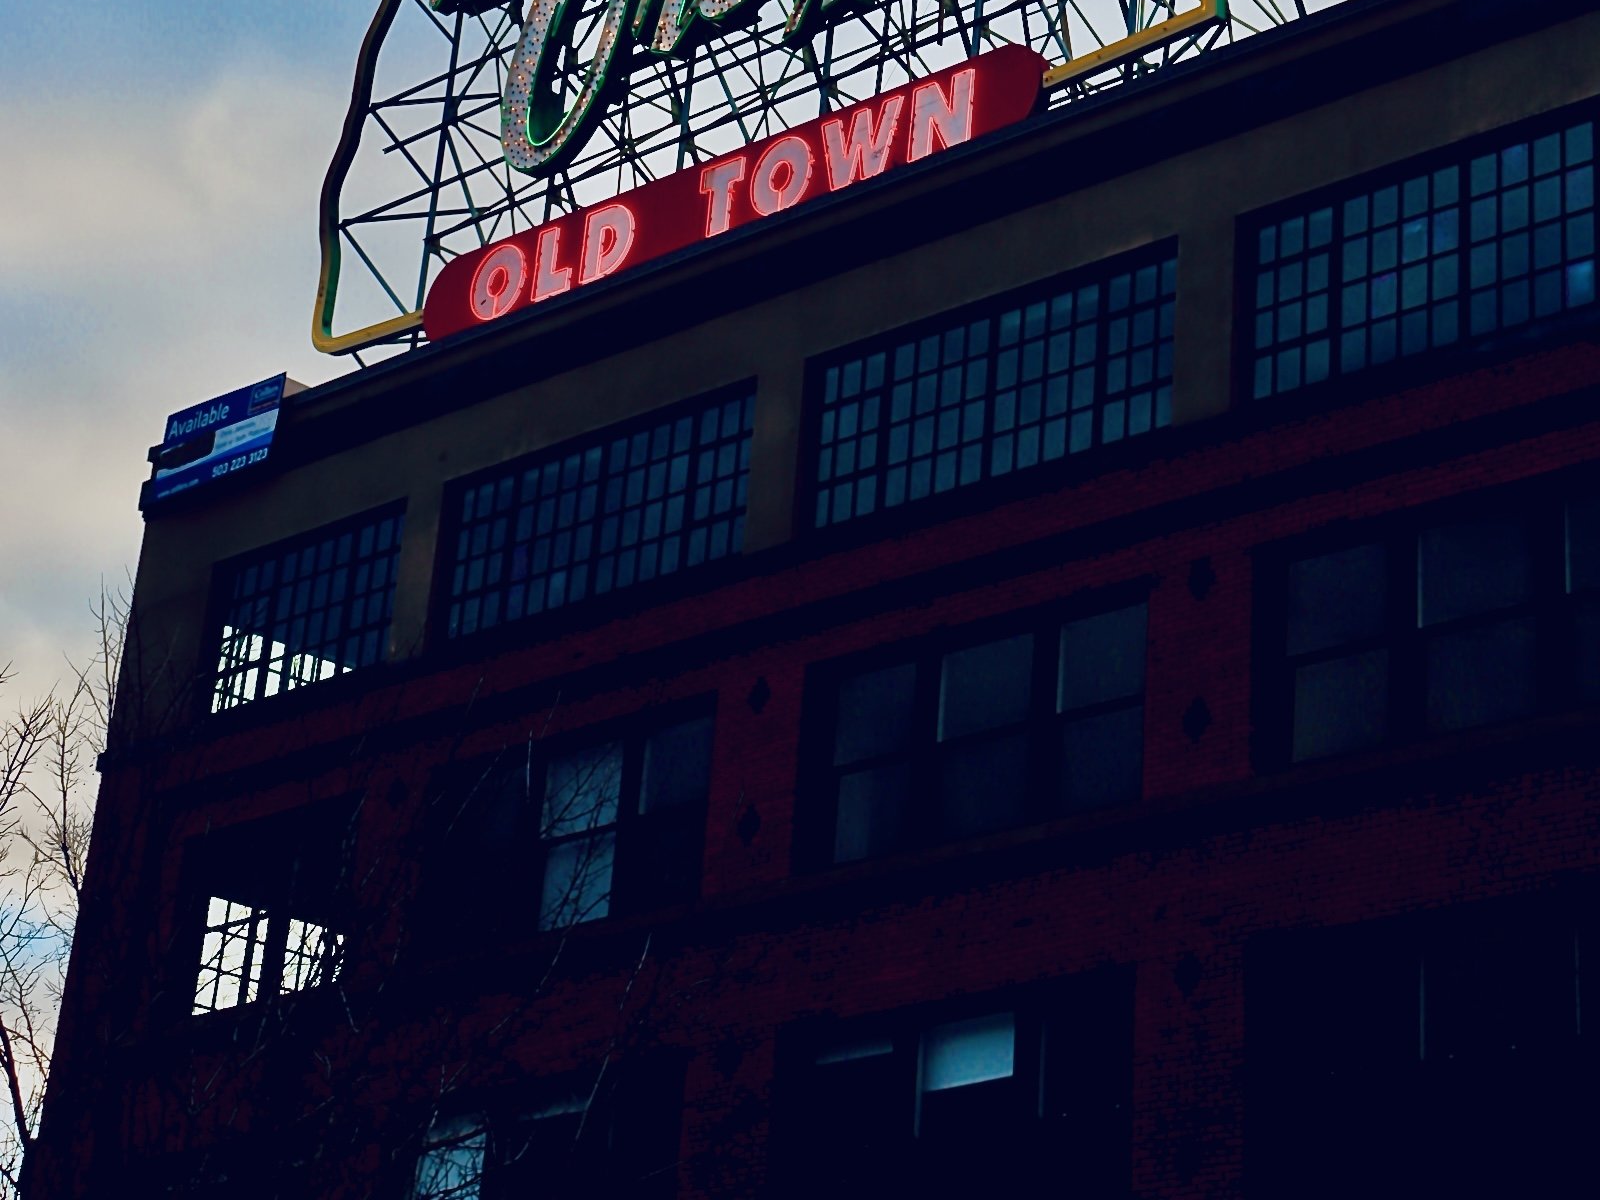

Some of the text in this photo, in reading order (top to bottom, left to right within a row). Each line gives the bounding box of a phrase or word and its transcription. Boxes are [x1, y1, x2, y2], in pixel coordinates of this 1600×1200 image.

[469, 67, 976, 322] OLD TOWN
[167, 402, 230, 440] Available
[230, 455, 247, 471] 223
[247, 447, 269, 464] 3123
